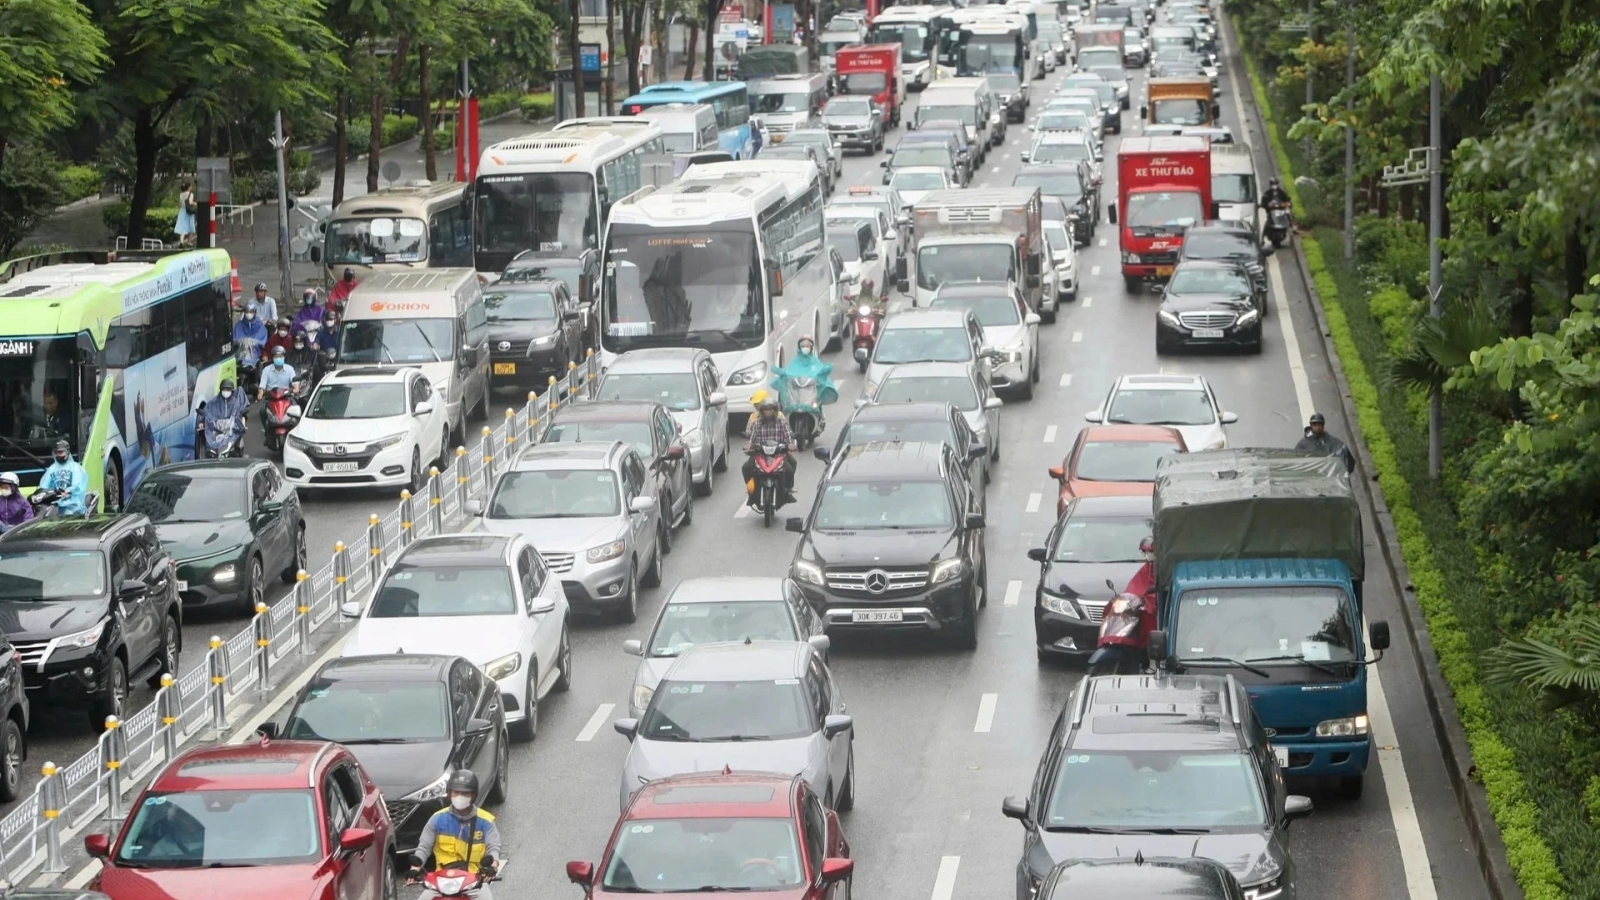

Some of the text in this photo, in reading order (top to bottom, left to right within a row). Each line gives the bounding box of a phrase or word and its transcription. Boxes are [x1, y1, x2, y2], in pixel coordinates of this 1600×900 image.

[1135, 165, 1194, 177] XE THƯ BÁO
[648, 238, 672, 247] LOTTE
[1149, 241, 1170, 250] J&T
[386, 302, 431, 310] ORION
[857, 612, 899, 621] 30K-397.46
